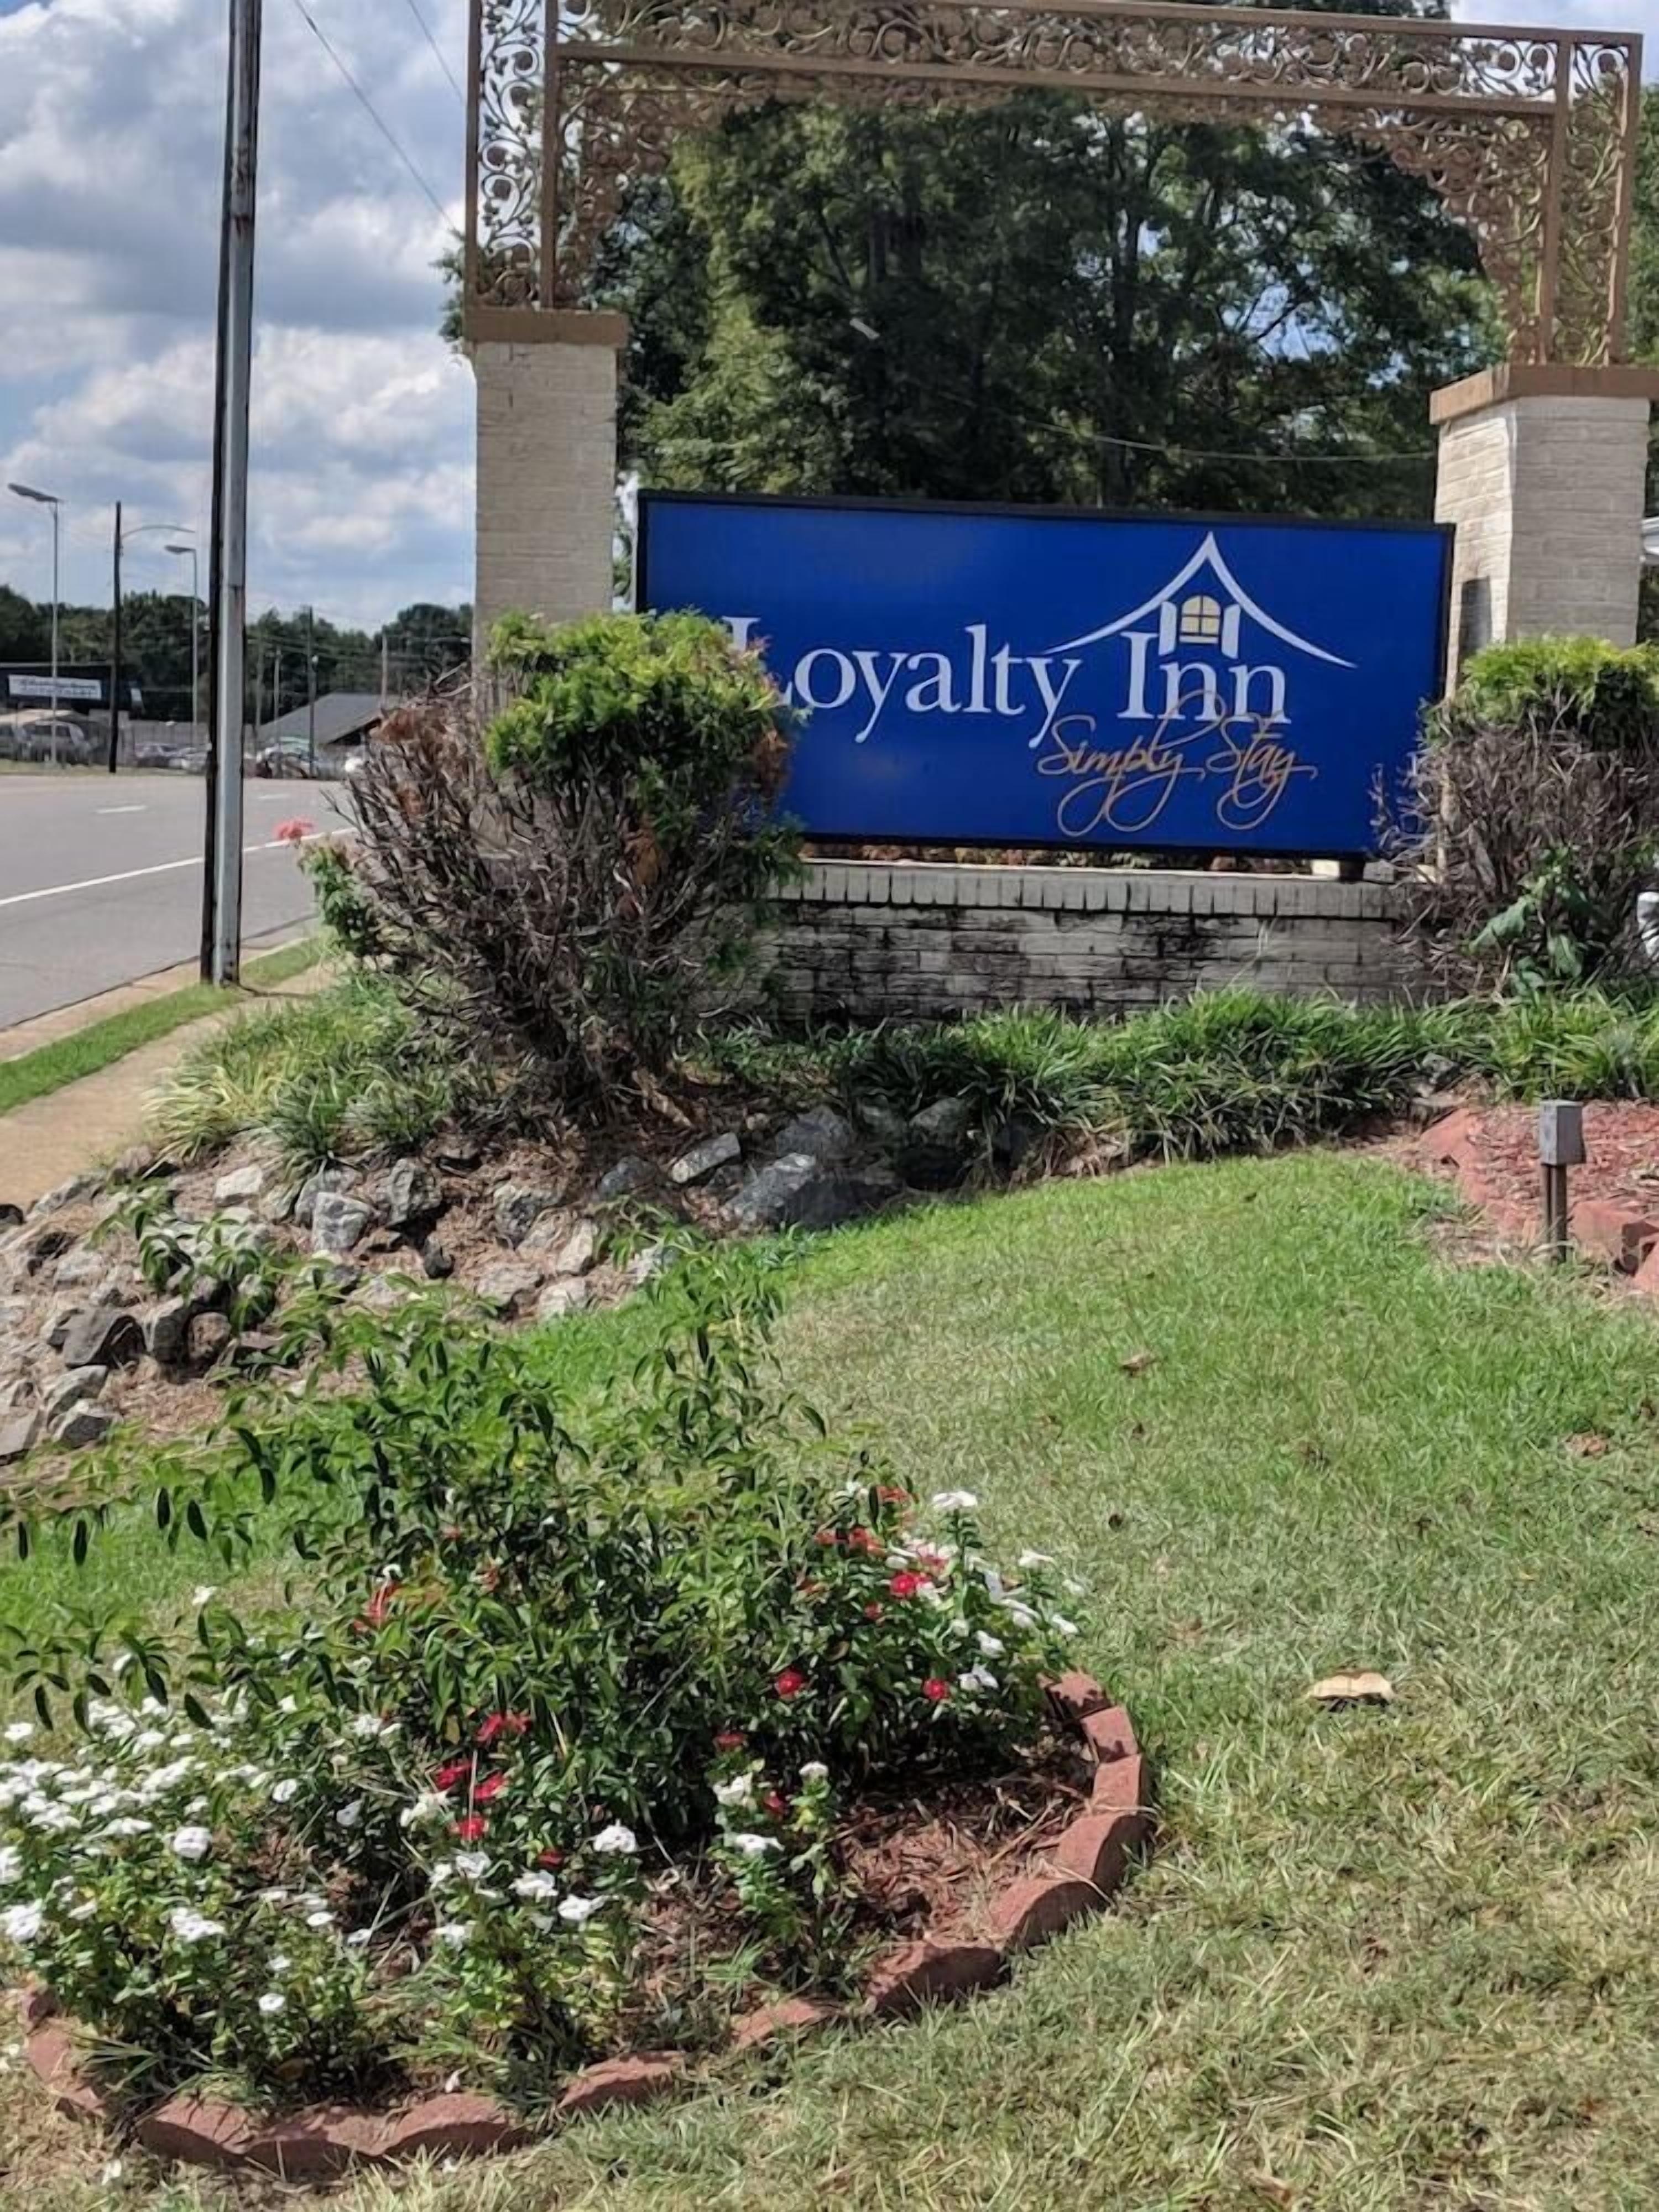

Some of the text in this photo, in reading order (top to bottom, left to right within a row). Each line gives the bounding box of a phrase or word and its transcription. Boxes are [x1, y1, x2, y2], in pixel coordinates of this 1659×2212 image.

[1116, 631, 1292, 724] Inn
[1037, 689, 1318, 837] Simply Stay
